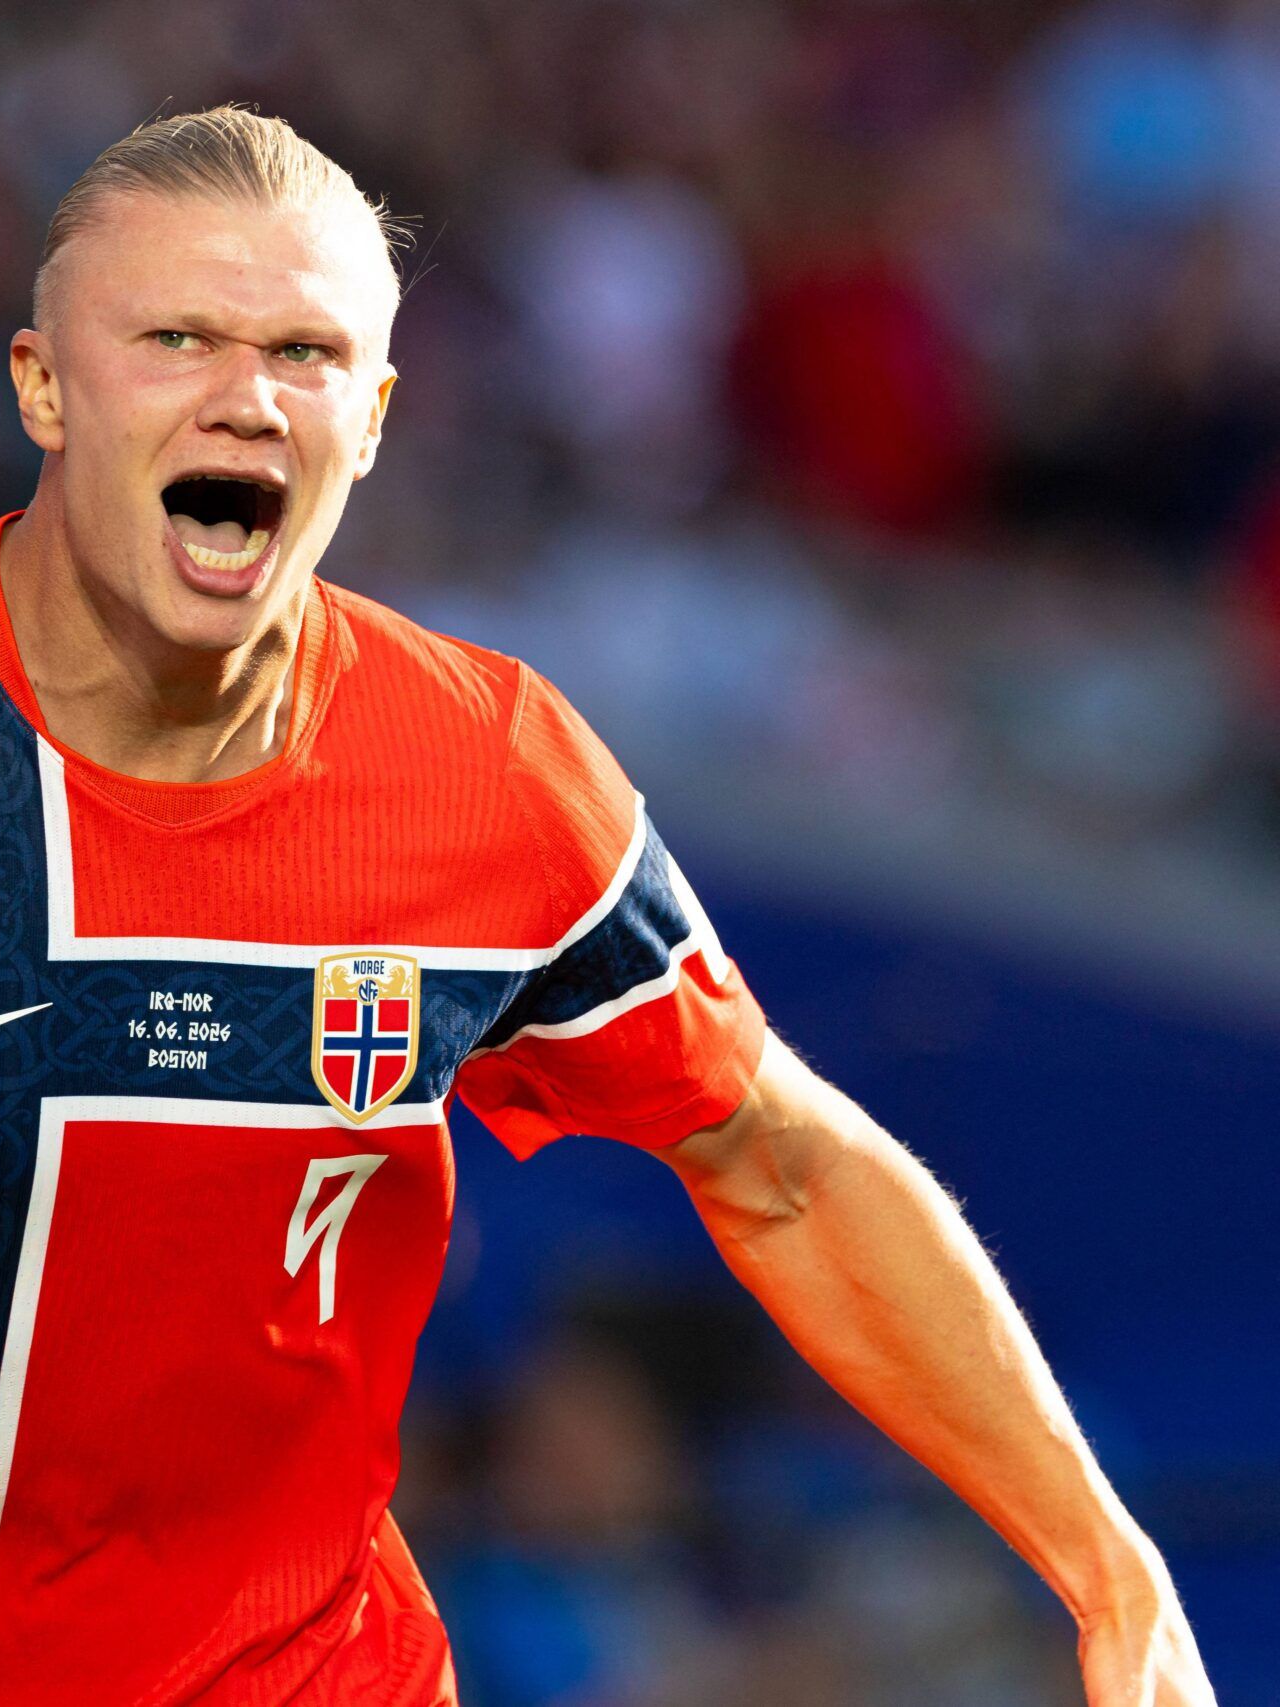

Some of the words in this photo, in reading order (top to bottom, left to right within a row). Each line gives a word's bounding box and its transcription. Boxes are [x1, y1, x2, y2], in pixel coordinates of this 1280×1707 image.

[353, 960, 385, 975] NORGE
[149, 991, 213, 1012] IRQ-NOR
[148, 1048, 207, 1070] BOSTON
[283, 1154, 390, 1326] 9
